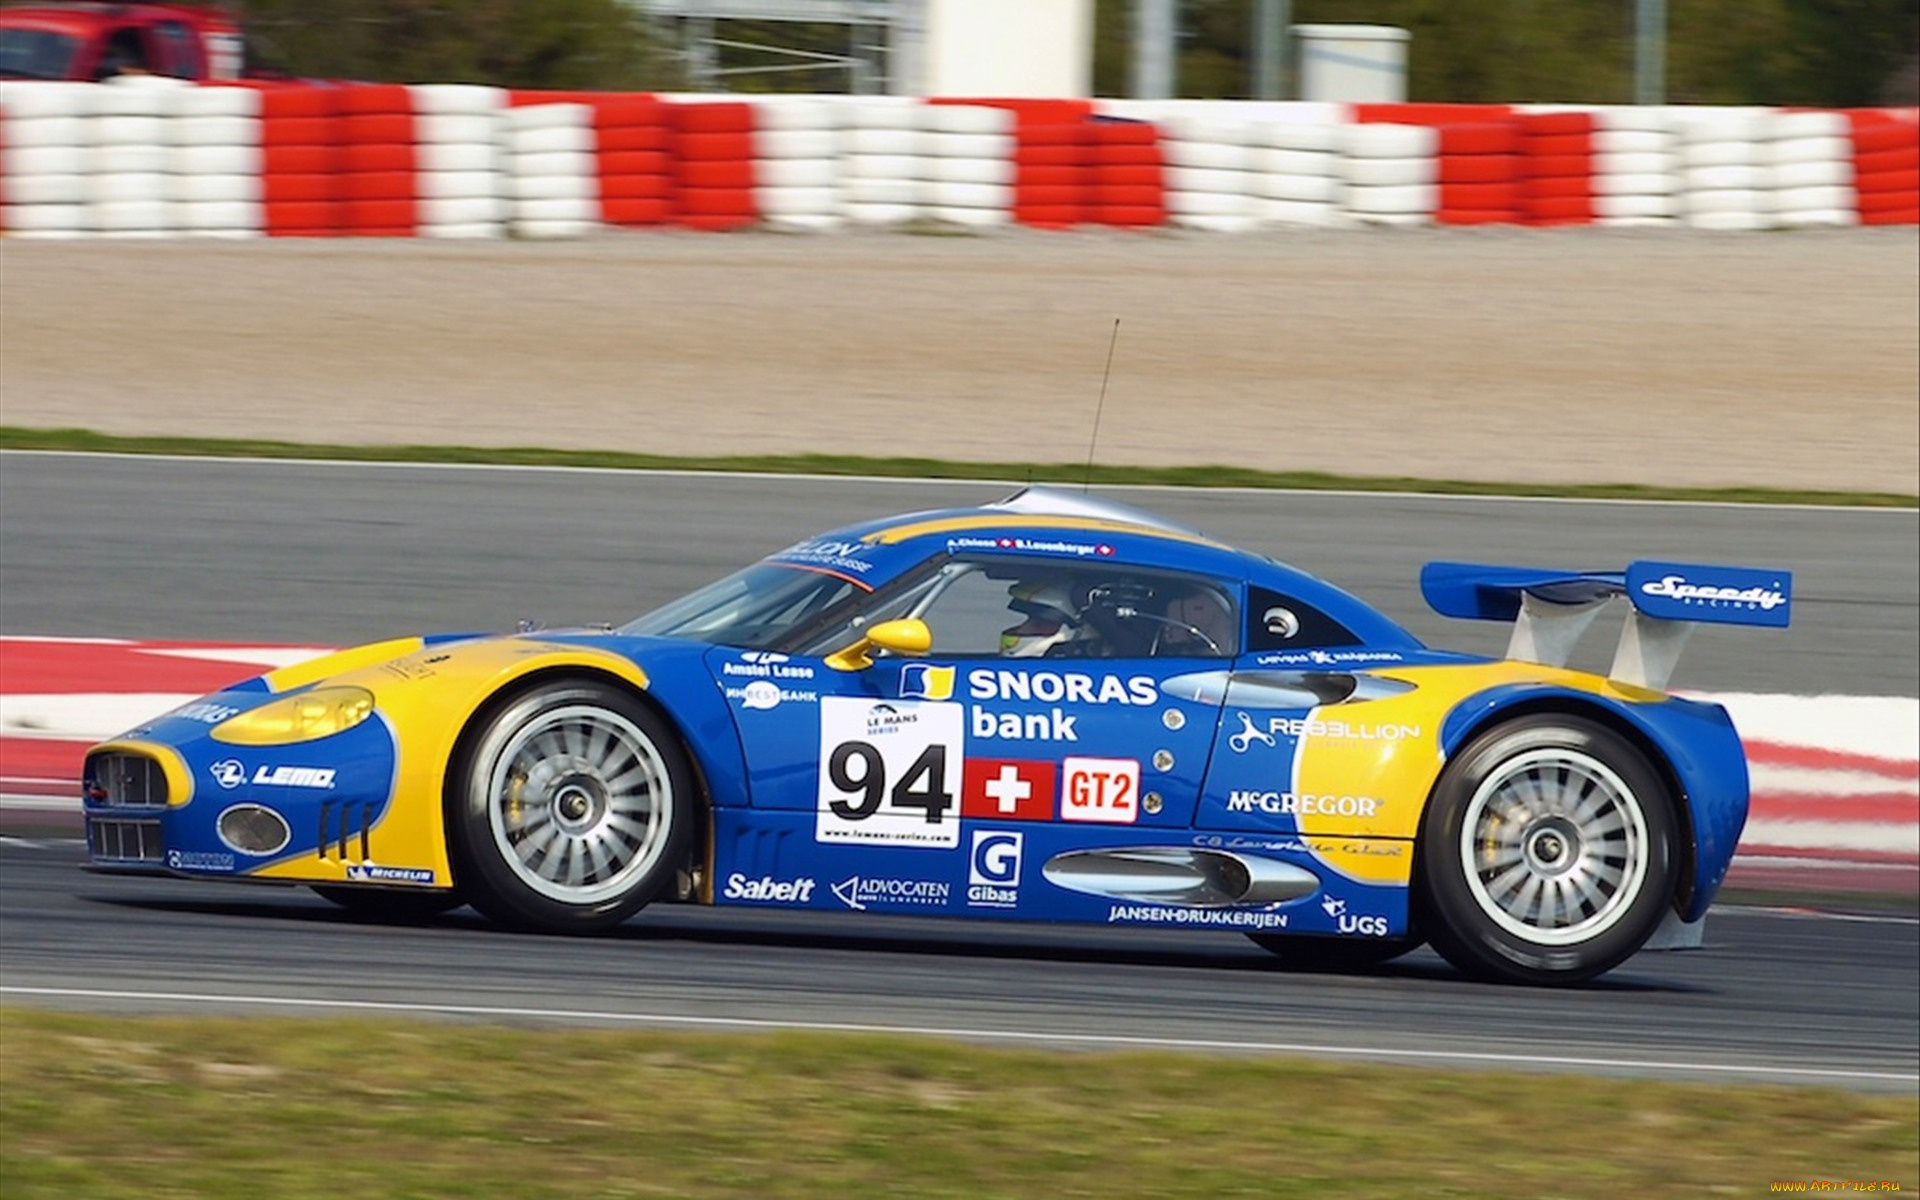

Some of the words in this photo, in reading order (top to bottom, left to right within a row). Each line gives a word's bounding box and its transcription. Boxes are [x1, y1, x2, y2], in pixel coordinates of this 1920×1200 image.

[1642, 576, 1787, 609] Speedy
[723, 662, 770, 677] Amstel
[773, 664, 814, 679] Lease
[970, 669, 1158, 706] SNORAS
[867, 718, 879, 727] LE
[884, 713, 918, 725] MANS
[972, 706, 1078, 742] bank
[252, 764, 336, 789] LEMO
[827, 740, 954, 825] 94
[1069, 770, 1132, 810] GT2
[370, 867, 432, 881] MICHELIN
[723, 873, 816, 902] Sabelt
[857, 879, 950, 898] ADVOCATEN
[967, 886, 1018, 903] Gibas
[1338, 914, 1389, 937] UGS
